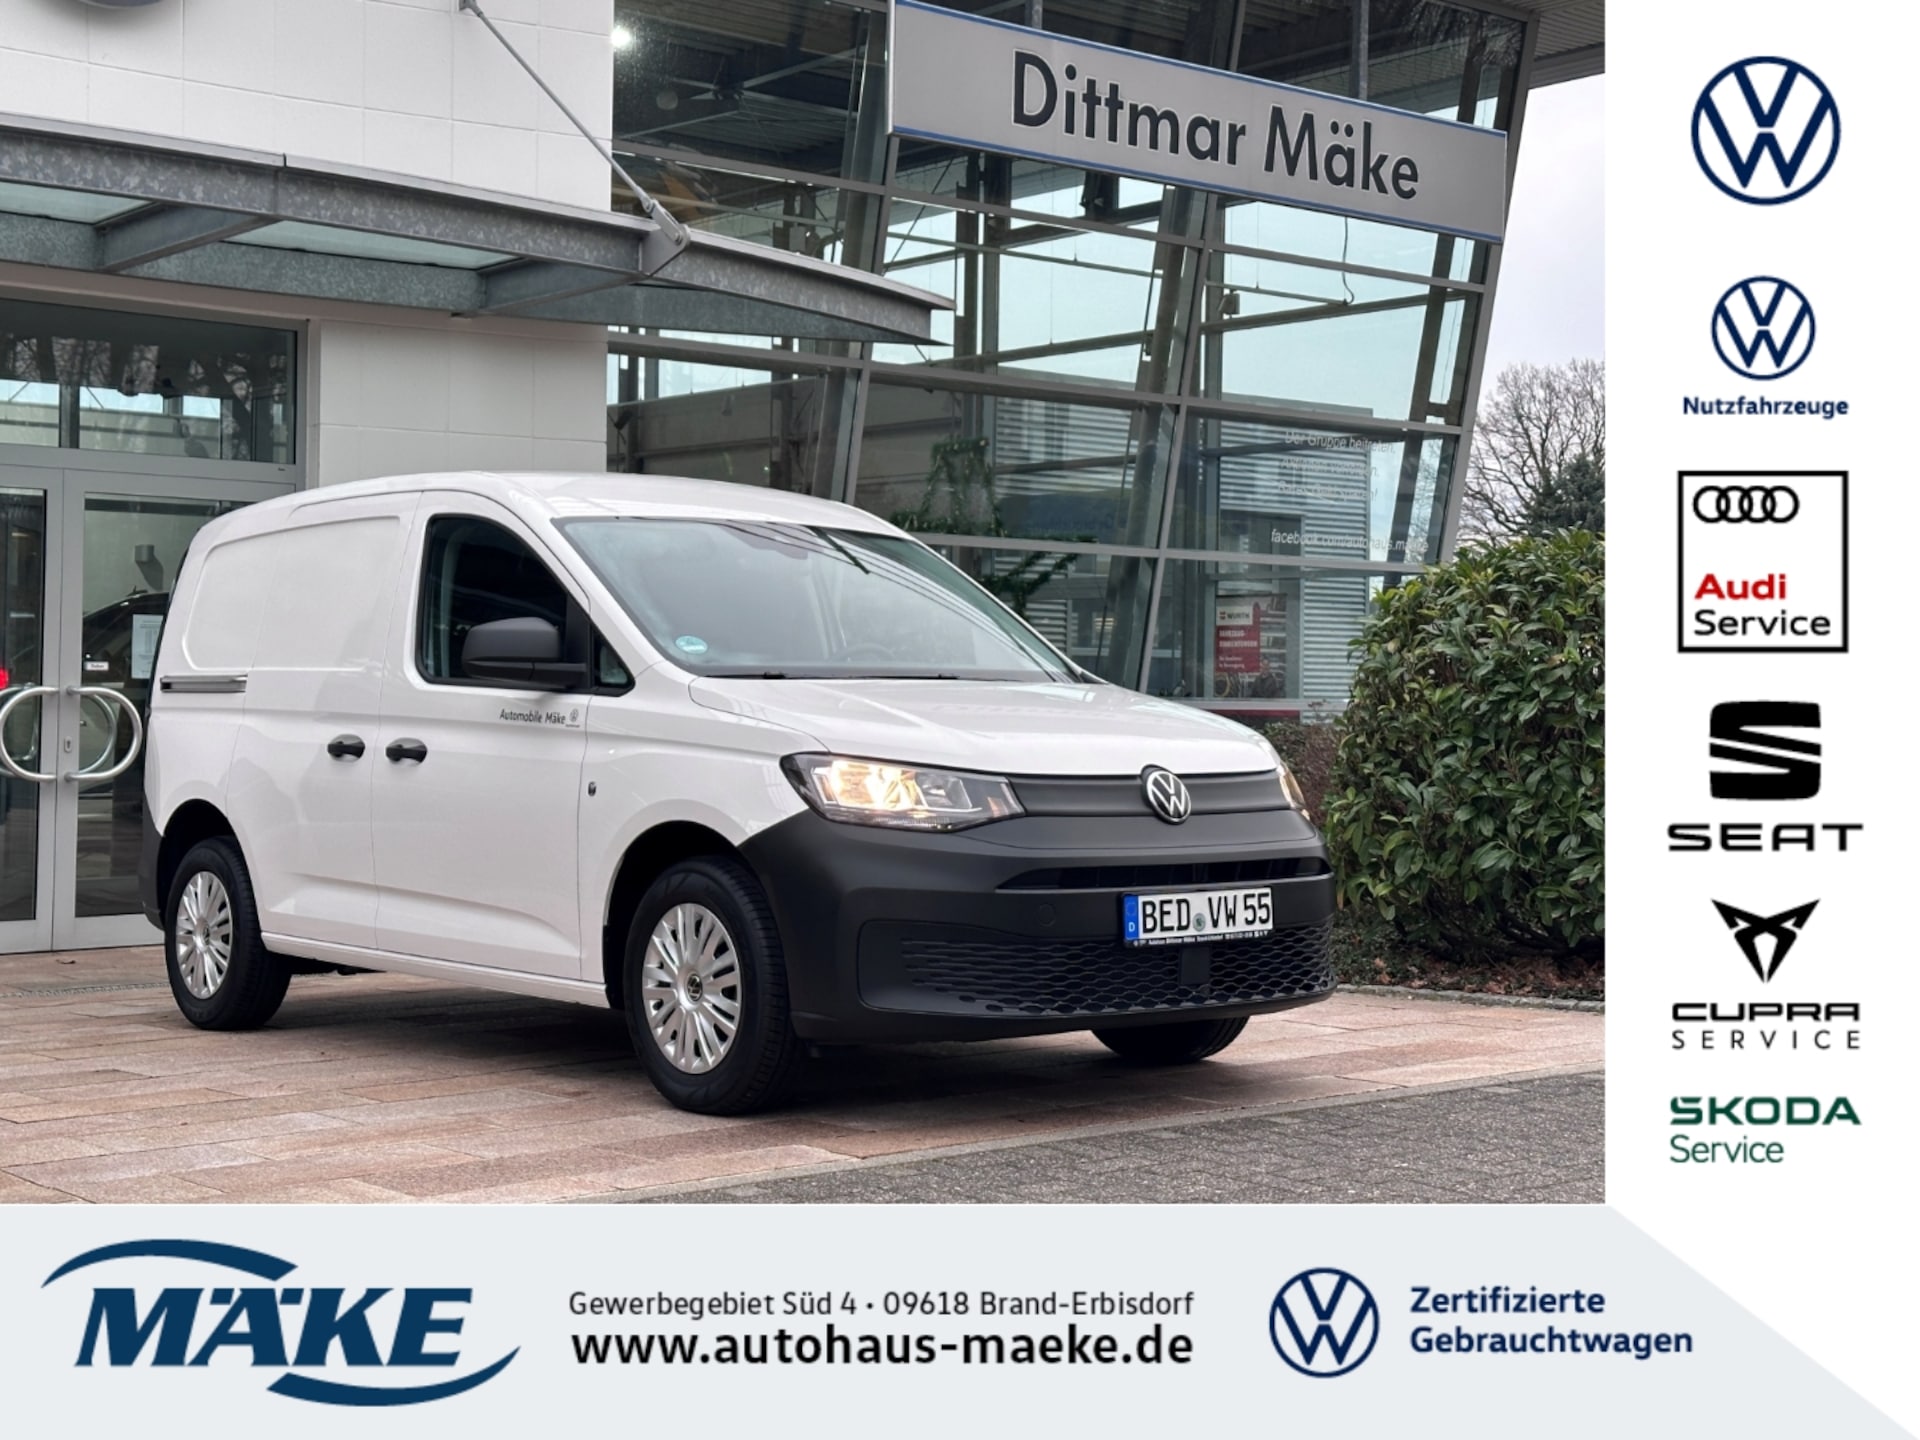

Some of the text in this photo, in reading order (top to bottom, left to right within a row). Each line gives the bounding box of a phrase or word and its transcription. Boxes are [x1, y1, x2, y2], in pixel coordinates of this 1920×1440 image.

[1012, 48, 1419, 200] Dittmar Mäke
[1307, 434, 1347, 450] Gruppe
[499, 708, 566, 725] Automobile Mäke
[1142, 898, 1191, 934] BED
[1208, 894, 1237, 929] VW
[1243, 892, 1271, 925] 55
